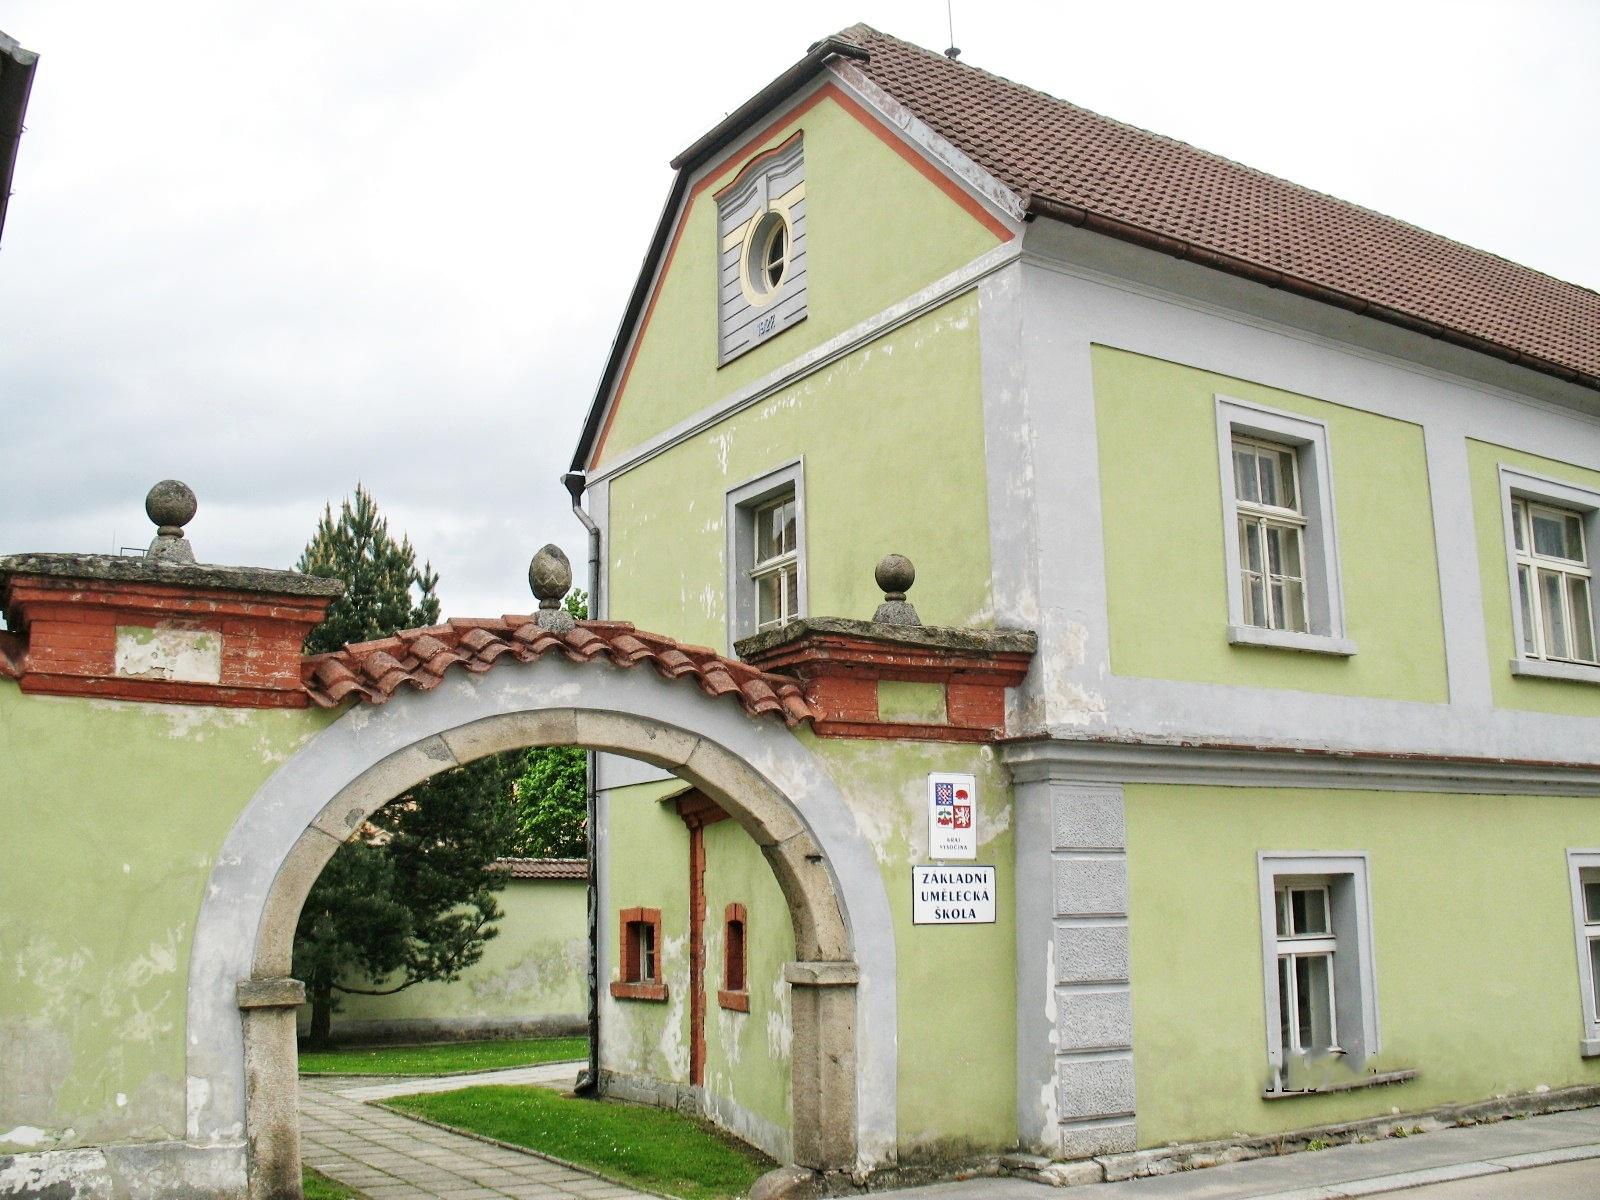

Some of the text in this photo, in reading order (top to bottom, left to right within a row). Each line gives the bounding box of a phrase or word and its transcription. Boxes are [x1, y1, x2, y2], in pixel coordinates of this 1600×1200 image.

[922, 871, 987, 884] ZÁKLADNÍ
[921, 888, 989, 902] UMĚLECKÁ
[935, 907, 977, 919] ŠKOLA
